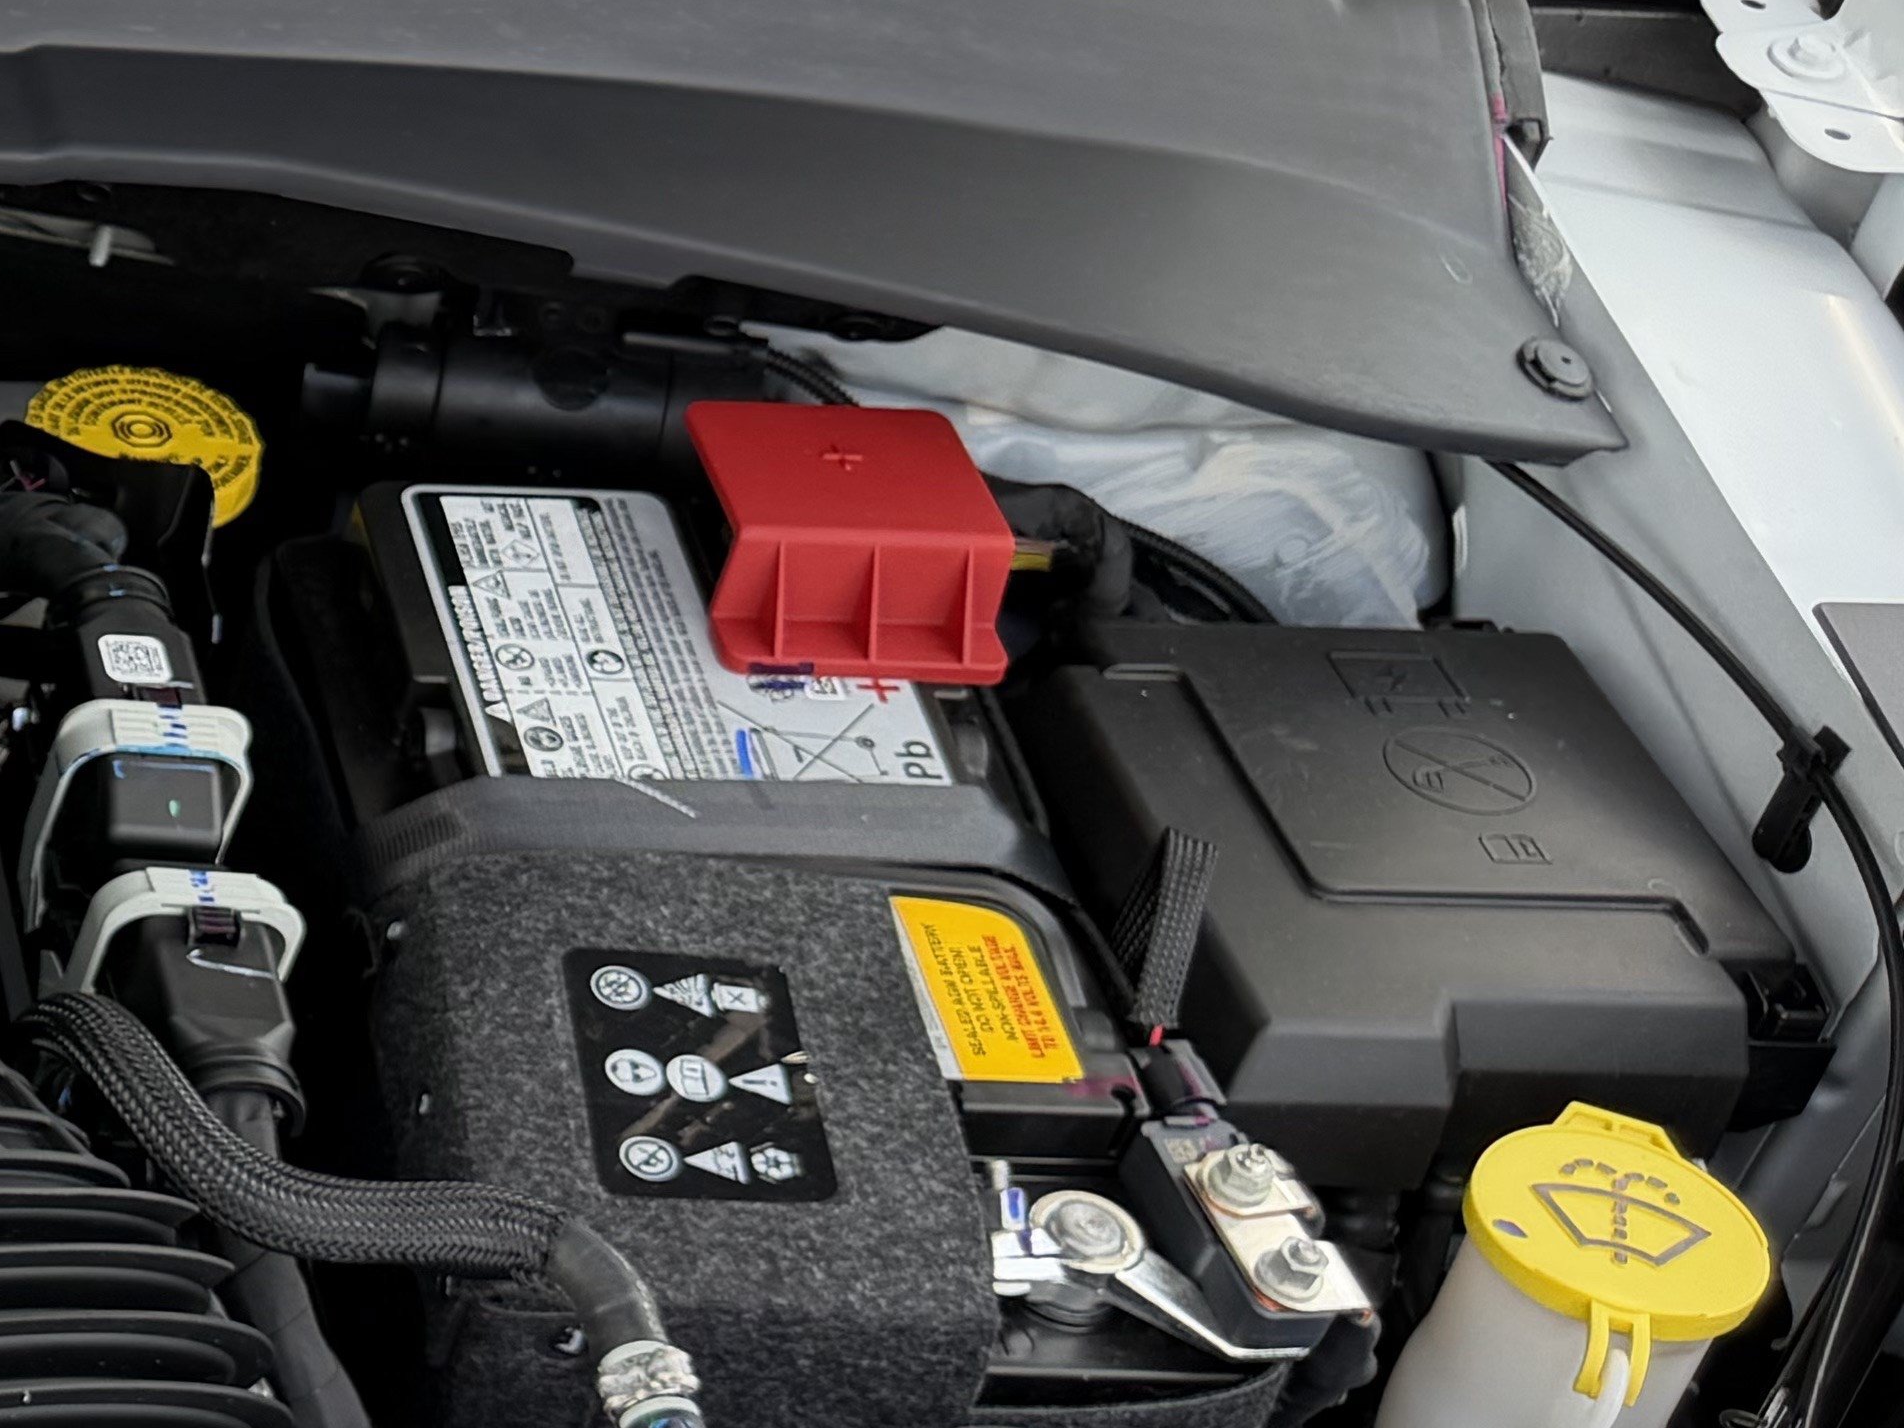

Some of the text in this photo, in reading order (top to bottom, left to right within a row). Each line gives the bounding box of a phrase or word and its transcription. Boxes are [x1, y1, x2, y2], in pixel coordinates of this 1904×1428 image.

[894, 739, 942, 780] Pb
[922, 923, 954, 975] BATTERY
[962, 987, 987, 1011] NOT
[966, 945, 1019, 1040] NON-SPILLABLE
[957, 1010, 987, 1055] SEALED
[974, 1014, 994, 1032] DO
